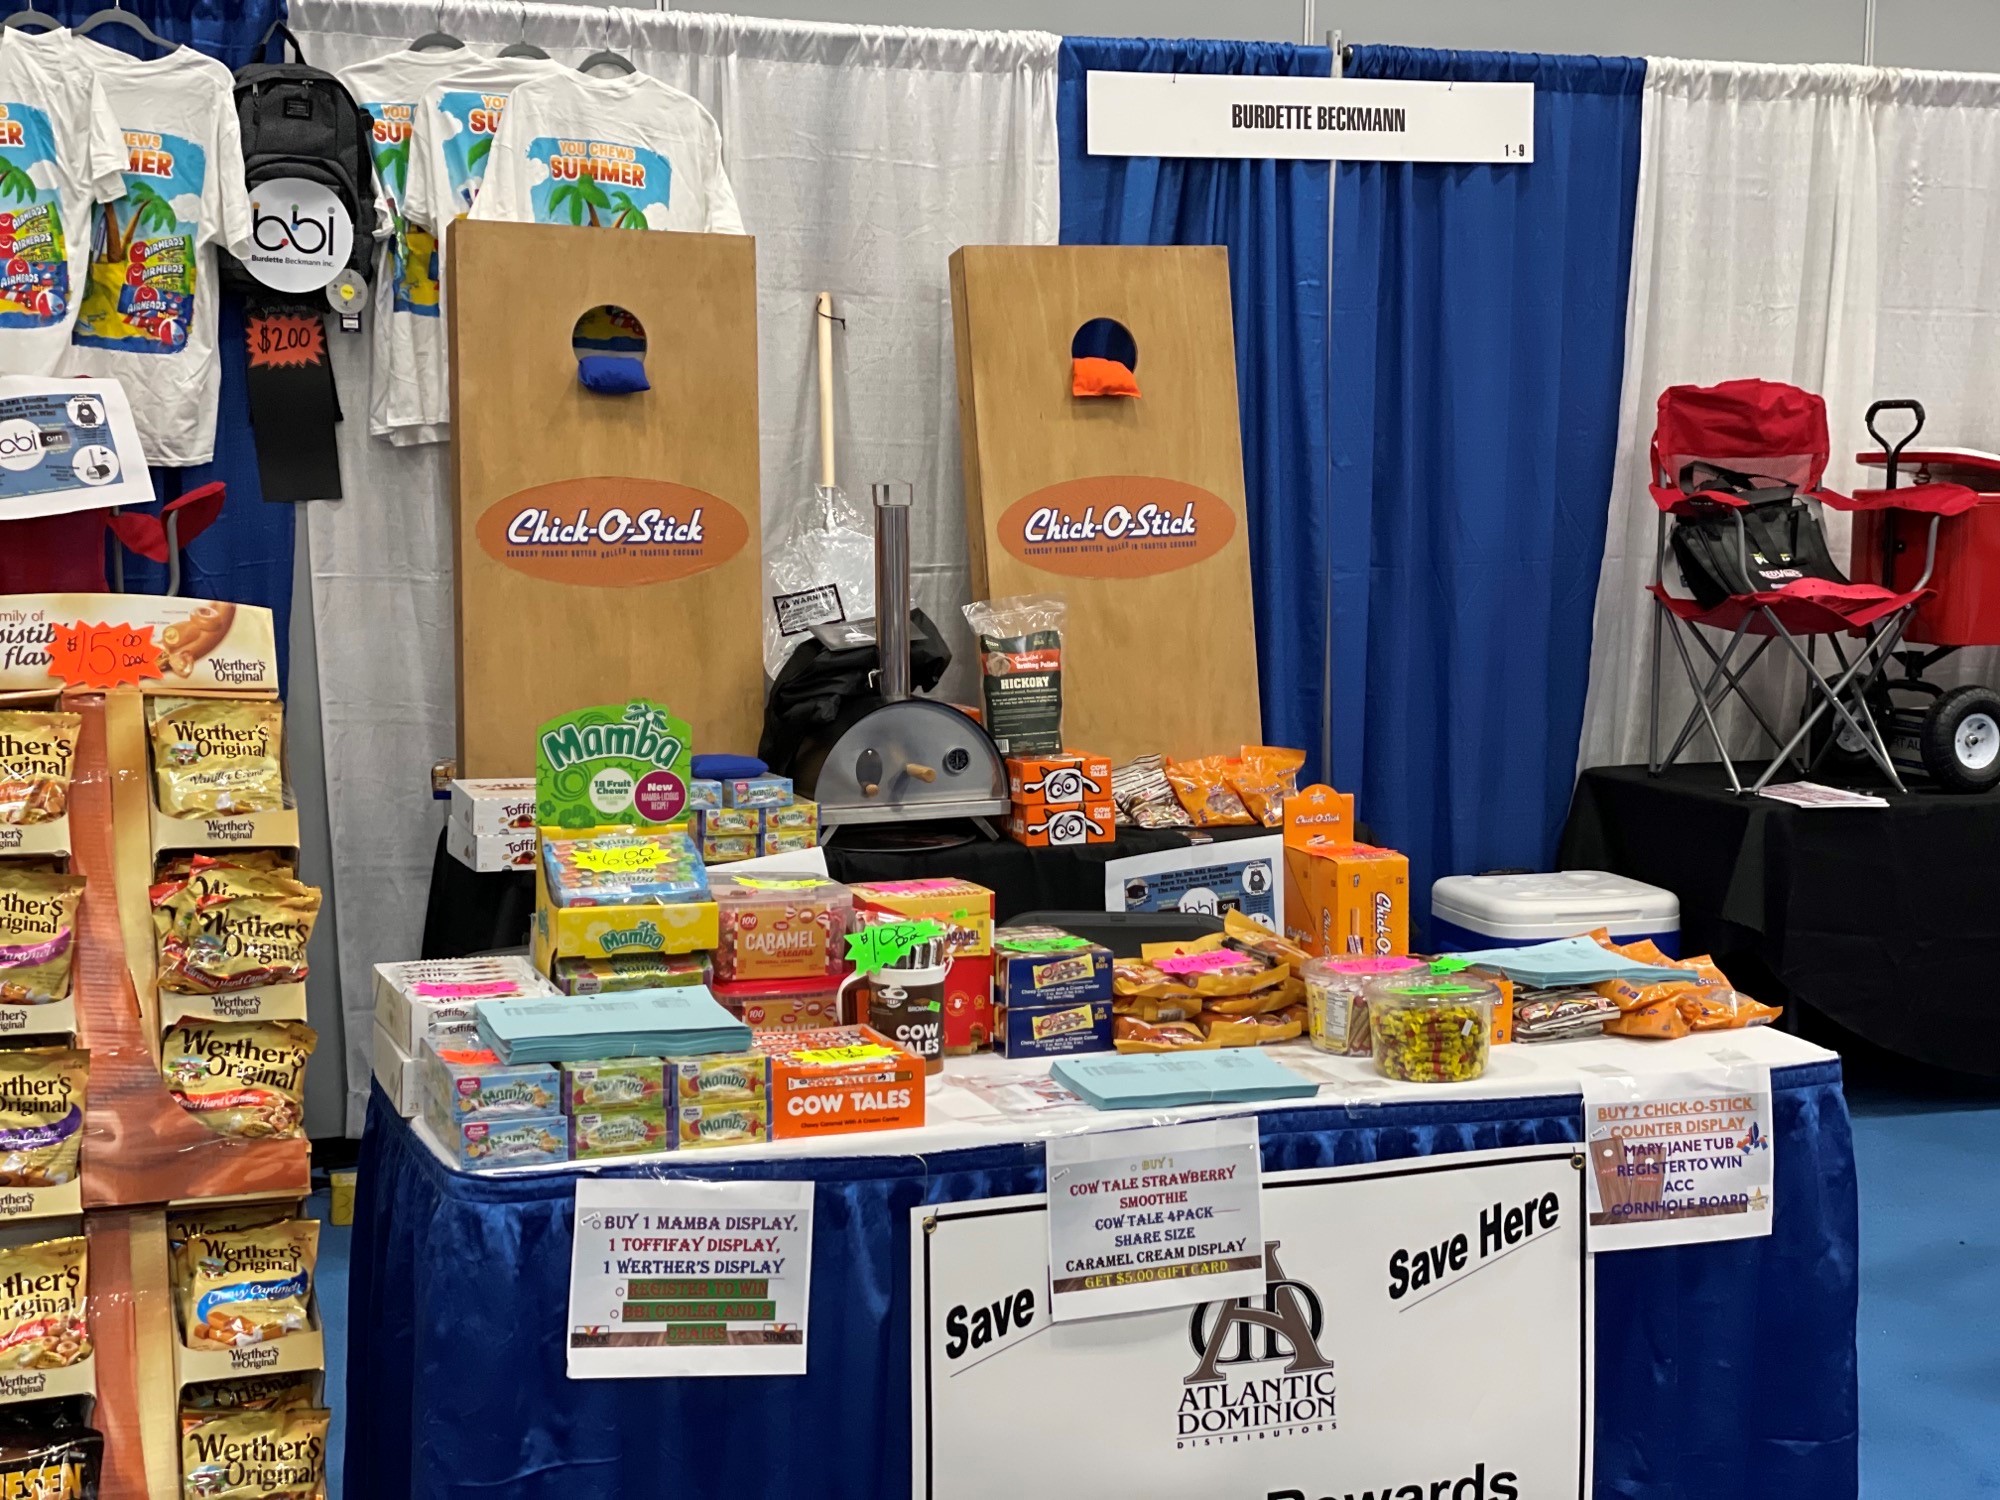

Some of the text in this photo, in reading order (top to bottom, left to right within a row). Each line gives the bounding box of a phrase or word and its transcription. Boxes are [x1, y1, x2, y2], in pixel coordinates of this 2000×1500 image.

[382, 105, 410, 118] YOU
[1231, 104, 1406, 132] BURDETTE BECKMANN
[558, 141, 635, 161] YOU CHEWS
[550, 156, 646, 188] SUMMER
[144, 237, 185, 257] AIRHEADS
[252, 255, 283, 264] Burdette
[285, 257, 321, 266] Beckmann
[142, 264, 184, 281] AIRHEADS
[127, 301, 166, 314] AIRHEADS
[506, 507, 704, 545] Chick-O-Stick
[1024, 501, 1197, 542] Chick-O-Stick
[31, 610, 44, 622] of
[209, 658, 266, 672] Werther's
[215, 669, 264, 683] Original
[1001, 676, 1049, 690] HICKORY
[169, 719, 269, 742] Werther's
[196, 740, 267, 759] Original
[541, 714, 683, 771] Mamba
[1090, 764, 1107, 772] COW
[594, 780, 631, 789] 18 Fruit
[596, 787, 629, 796] Chews
[647, 783, 673, 792] New
[1094, 806, 1110, 814] COW
[207, 820, 254, 832] Werther's
[217, 829, 253, 841] Original
[201, 910, 309, 943] Werther's
[741, 915, 757, 926] 100
[600, 921, 665, 953] Mamba
[745, 930, 816, 955] CARAMEL
[222, 934, 305, 964] Original
[776, 949, 813, 958] creams
[221, 975, 241, 987] Hard
[212, 995, 261, 1008] Werther's
[224, 1004, 259, 1016] Original
[434, 1008, 469, 1019] Toffifay
[749, 1009, 764, 1019] 100
[896, 1023, 939, 1041] COW
[180, 1028, 306, 1068] Werther's
[206, 1056, 300, 1092] Original
[699, 1071, 747, 1092] Mamba
[482, 1085, 534, 1103] Mamba
[787, 1089, 911, 1117] COW TALES
[1597, 1097, 1754, 1120] BUY 2 CHICK-O-STICK
[699, 1114, 747, 1137] Mamba
[1610, 1116, 1746, 1139] COUNTER DISPLAY
[1624, 1137, 1734, 1157] MARY JANE TUB
[1141, 1156, 1174, 1171] BUY 1
[1617, 1155, 1742, 1177] REGISTER TO WIN
[1069, 1164, 1237, 1196] COW TALE STRAWBERRY
[1664, 1179, 1695, 1193] ACC
[1119, 1190, 1188, 1209] SMOOTHIE
[1611, 1192, 1749, 1216] CORNHOLE BOARD
[604, 1213, 798, 1232] BUY 1 MAMBA DISPLAY,
[1094, 1206, 1214, 1231] COW TALE 4PACK
[608, 1236, 781, 1253] 1 TOFFIFAY DISPLAY,
[1114, 1227, 1197, 1248] SHARE SIZE
[1388, 1191, 1560, 1300] Save Here
[200, 1238, 302, 1260] Werther's
[1066, 1237, 1247, 1272] CARAMEL CREAM DISPLAY
[224, 1256, 297, 1274] Original
[603, 1258, 786, 1275] 1 WERTHER'S DISPLAY
[1084, 1260, 1229, 1289] GET $5.00 GIFT CARD
[208, 1288, 250, 1305] Chewy
[628, 1281, 768, 1297] REGISTER TO WIN
[623, 1303, 770, 1318] BBI COOLER AND 2
[946, 1284, 1036, 1359] Save
[667, 1326, 727, 1341] CHAIRS
[229, 1346, 279, 1360] Werther's
[242, 1357, 277, 1369] Original
[6, 1384, 44, 1397] Original
[1178, 1370, 1337, 1412] ATLANTIC
[1177, 1396, 1337, 1436] DOMINION
[1177, 1422, 1338, 1449] DISTRIBUTORS
[190, 1432, 322, 1464] Werther's
[224, 1458, 319, 1491] Original
